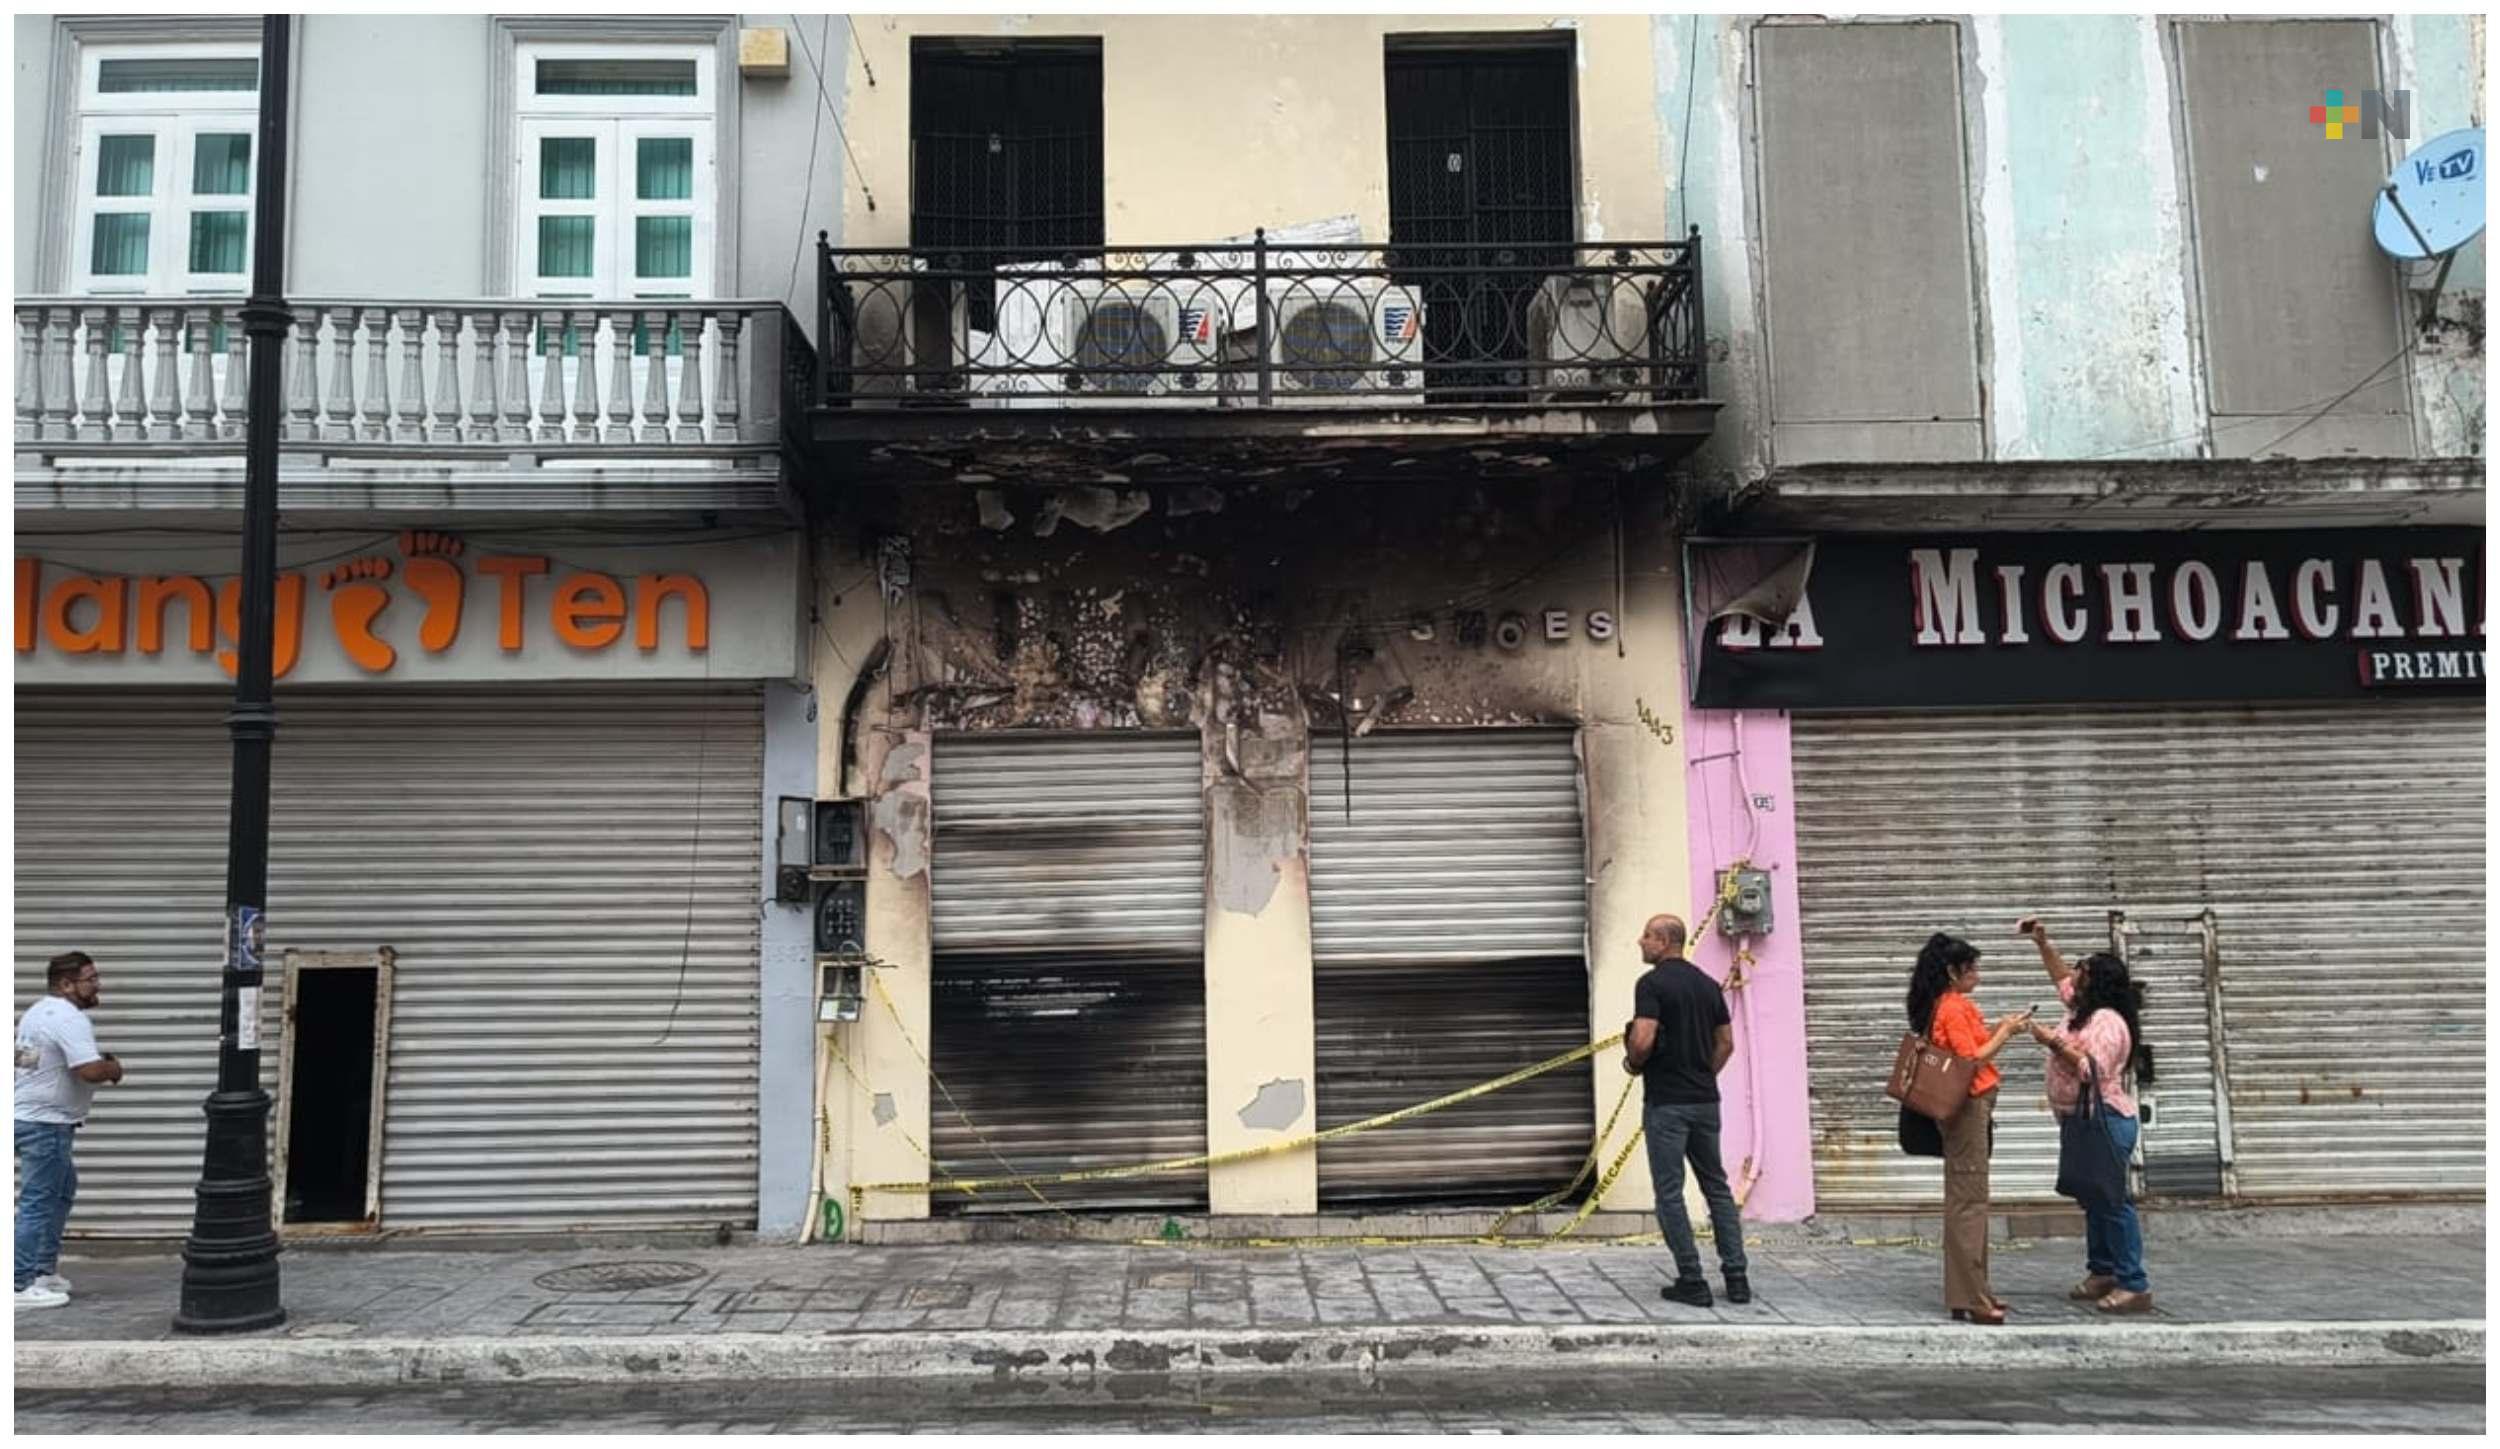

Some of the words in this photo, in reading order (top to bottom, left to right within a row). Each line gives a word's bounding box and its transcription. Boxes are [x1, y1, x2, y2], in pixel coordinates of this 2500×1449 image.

[477, 556, 711, 653] Ten
[1911, 548, 2486, 646] MICHOACAN
[2372, 651, 2486, 680] PREMI
